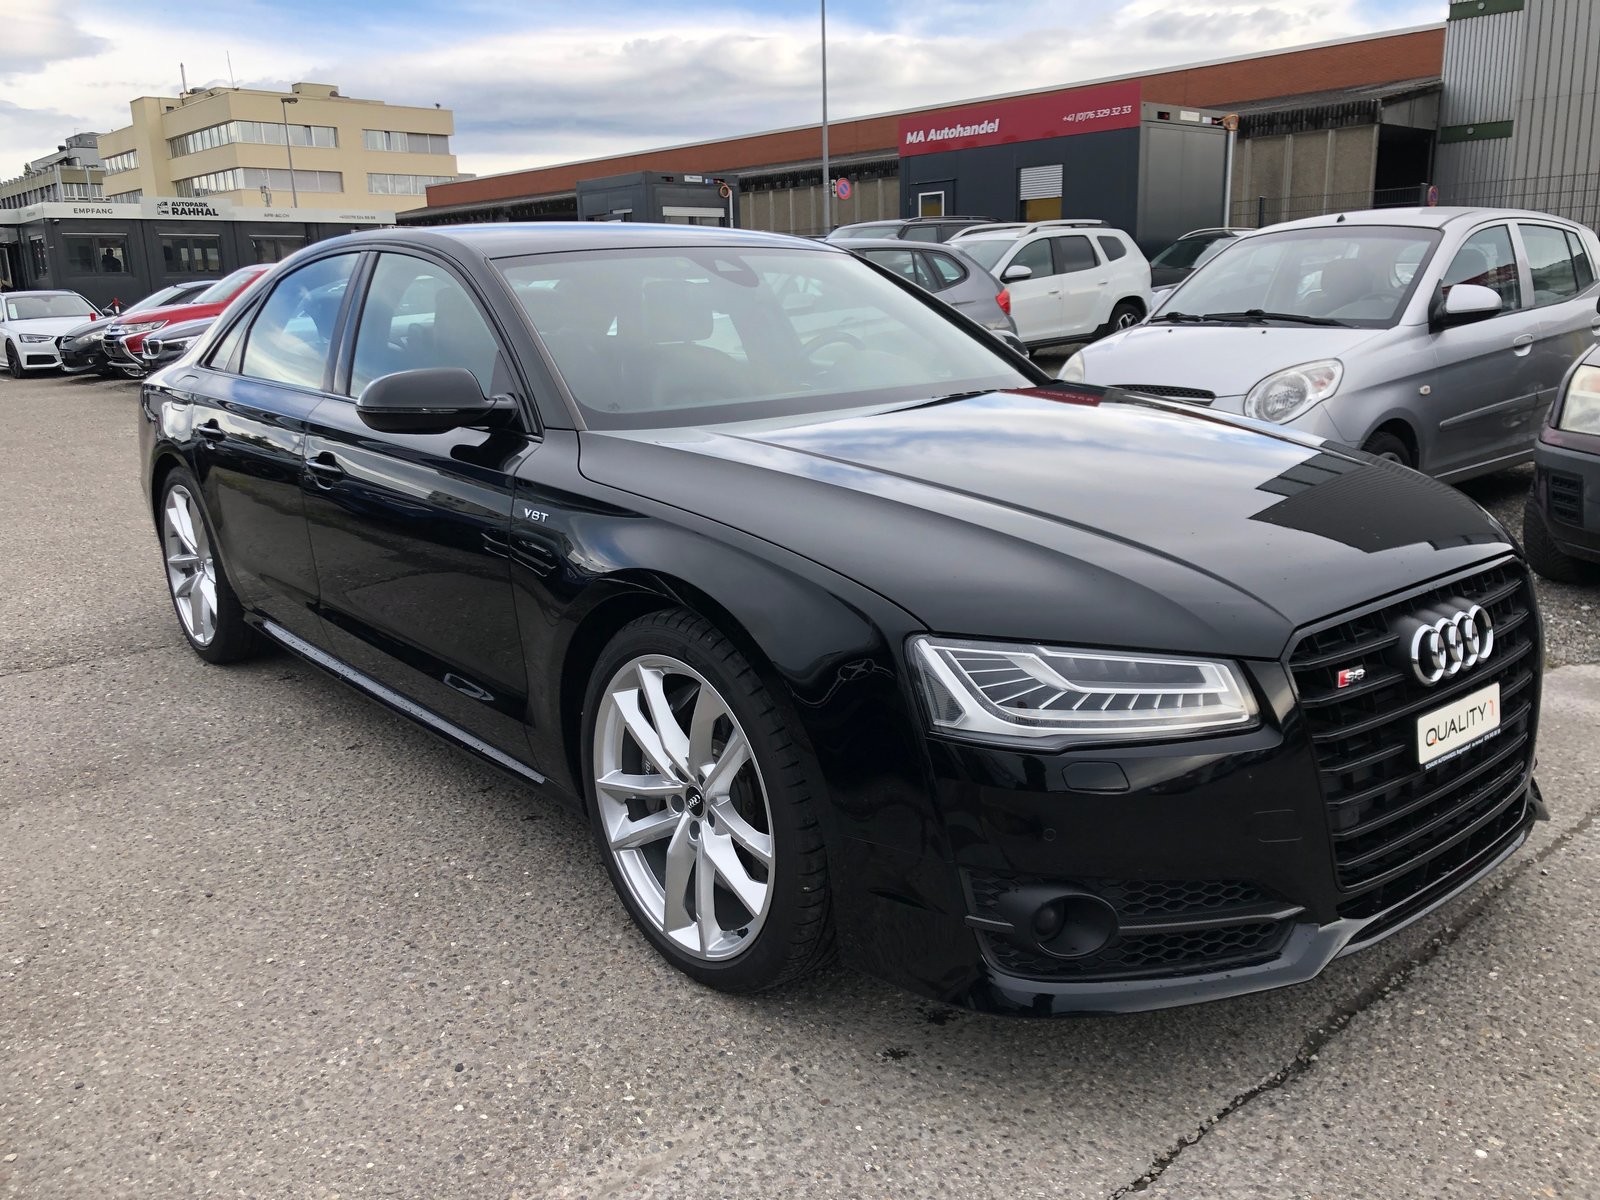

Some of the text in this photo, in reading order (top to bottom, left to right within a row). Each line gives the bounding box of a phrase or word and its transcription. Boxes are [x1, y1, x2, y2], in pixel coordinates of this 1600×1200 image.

[1062, 113, 1076, 122] +41
[1096, 108, 1111, 119] 329
[1110, 106, 1122, 116] 32
[1121, 105, 1133, 115] 33
[906, 119, 1000, 145] MA Autohandel
[171, 207, 220, 216] RAHHAL
[523, 508, 549, 523] V8T
[1344, 668, 1366, 682] S8
